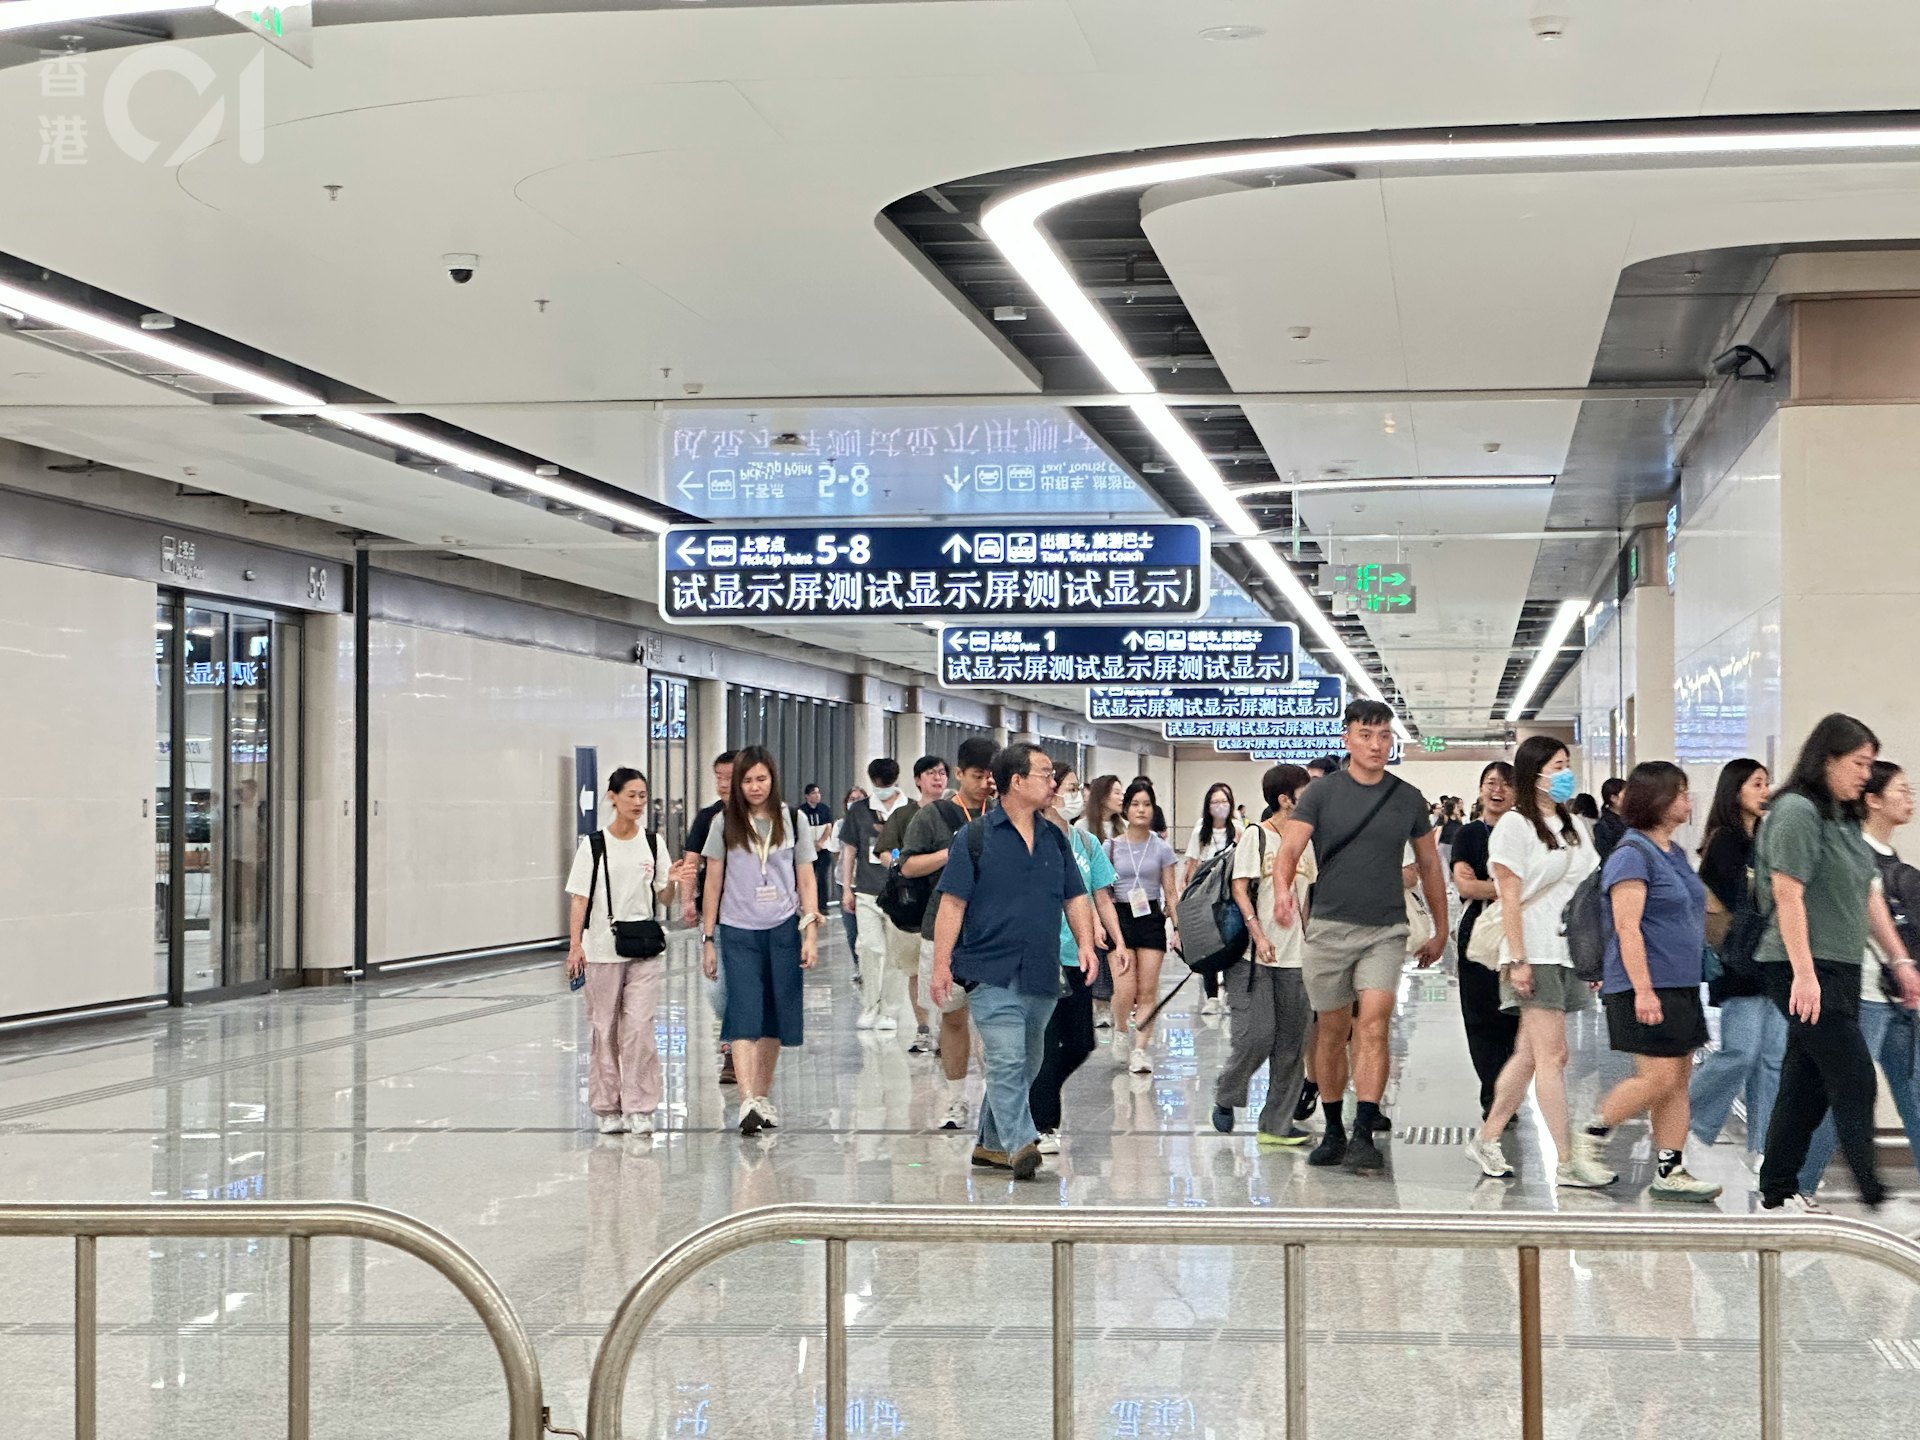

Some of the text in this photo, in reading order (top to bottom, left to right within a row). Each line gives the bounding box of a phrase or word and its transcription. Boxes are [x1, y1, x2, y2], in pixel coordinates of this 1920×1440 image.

[740, 536, 786, 553] 上客点
[816, 534, 871, 565] 5-8
[783, 553, 813, 566] Point
[1070, 550, 1108, 563] Tourist
[1109, 550, 1144, 562] Coach
[672, 569, 1192, 612] 试显示屏测试显示屏测试显示
[1043, 630, 1056, 652] 1
[947, 655, 1289, 681] 试显示屏测试显示屏测试显示
[1092, 698, 1339, 718] 试显示屏测试显示屏测试显示
[1167, 721, 1347, 737] 试显示屏测试显示屏测试显
